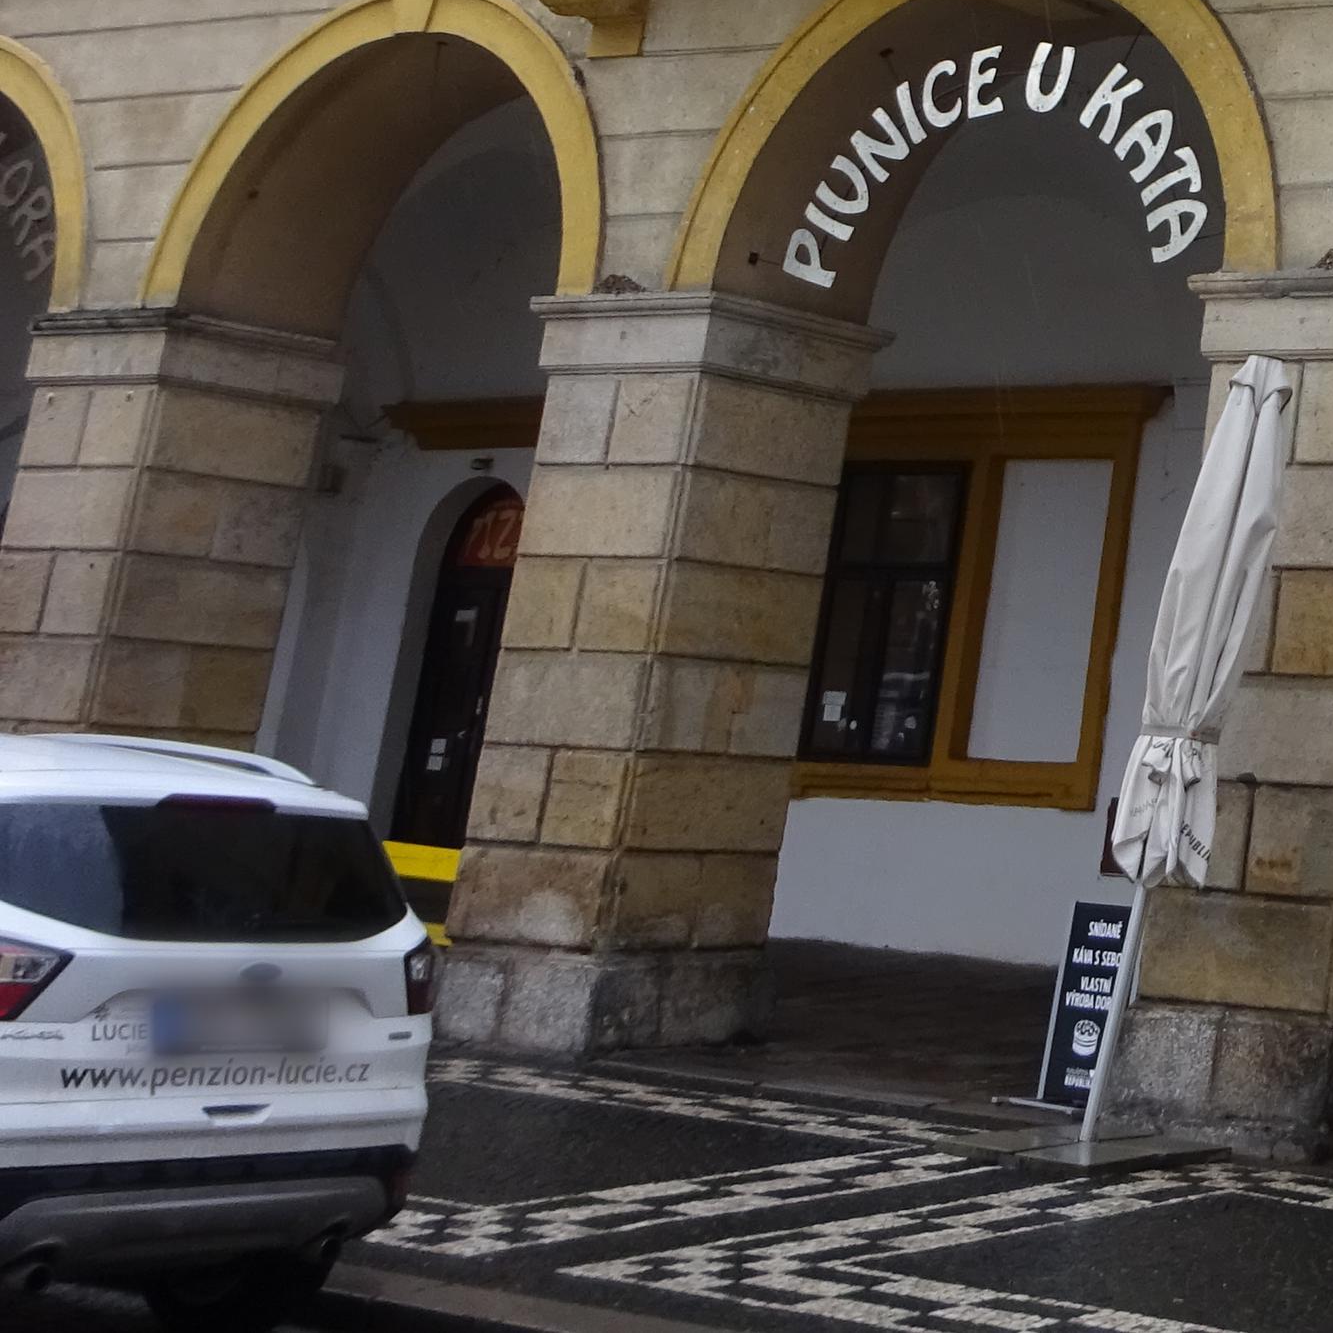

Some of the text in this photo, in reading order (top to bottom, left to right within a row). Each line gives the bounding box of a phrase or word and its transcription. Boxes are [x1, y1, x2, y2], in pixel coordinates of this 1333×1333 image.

[1024, 42, 1076, 113] U
[1079, 62, 1209, 264] KATA
[1088, 919, 1123, 939] SNÍDANĚ
[1072, 945, 1093, 965] KÁVA
[1094, 950, 1100, 965] S
[1081, 975, 1113, 994] VLASTNÍ
[1065, 989, 1094, 1009] VÝROBA
[91, 1023, 148, 1042] LUCIE
[59, 1056, 371, 1096] www.penzion-lucie.cz
